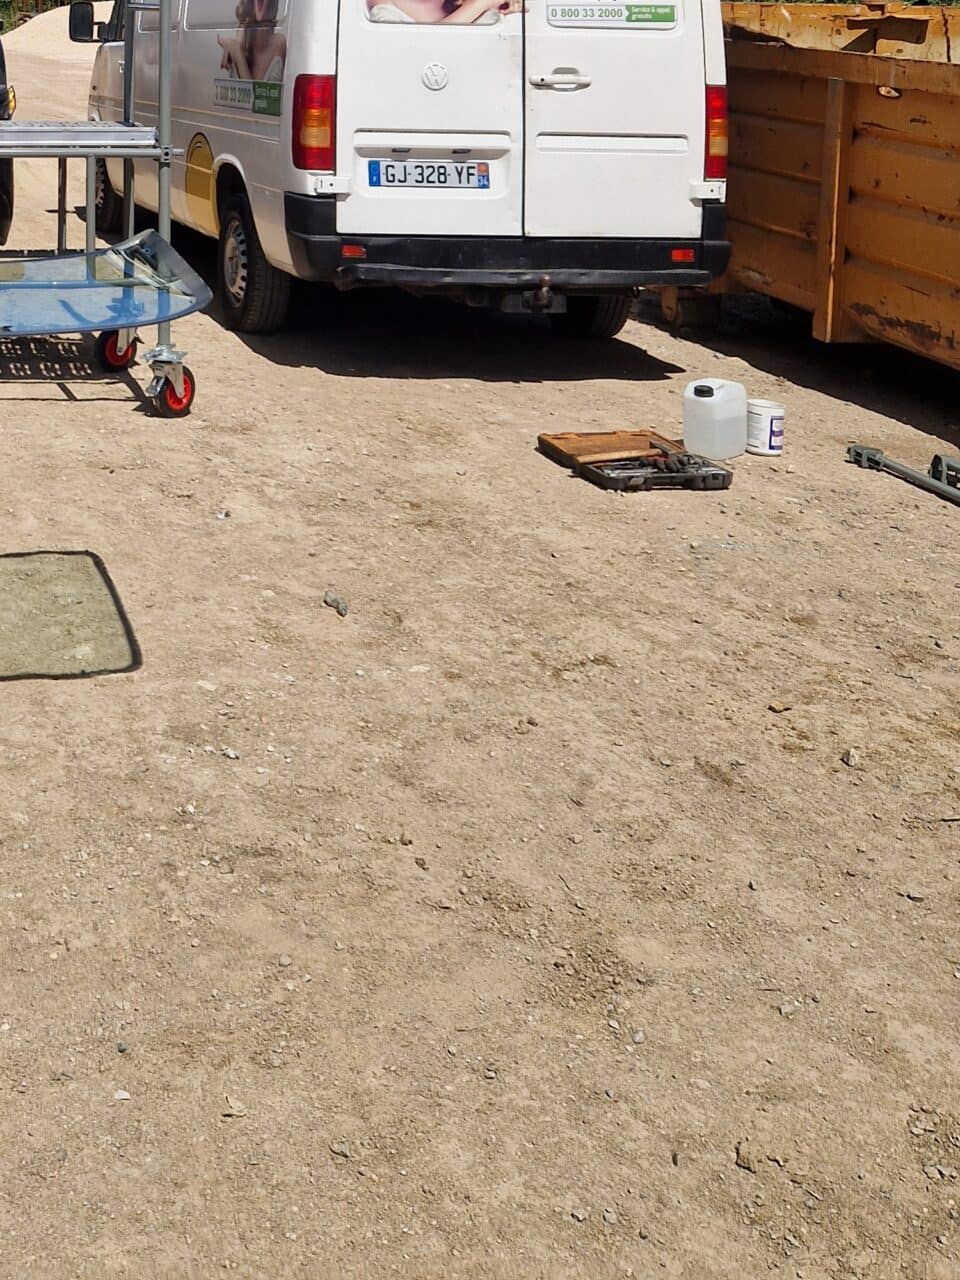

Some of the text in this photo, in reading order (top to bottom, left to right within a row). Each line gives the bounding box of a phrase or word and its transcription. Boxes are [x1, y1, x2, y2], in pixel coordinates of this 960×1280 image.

[551, 8, 623, 18] 0 800 33 2000
